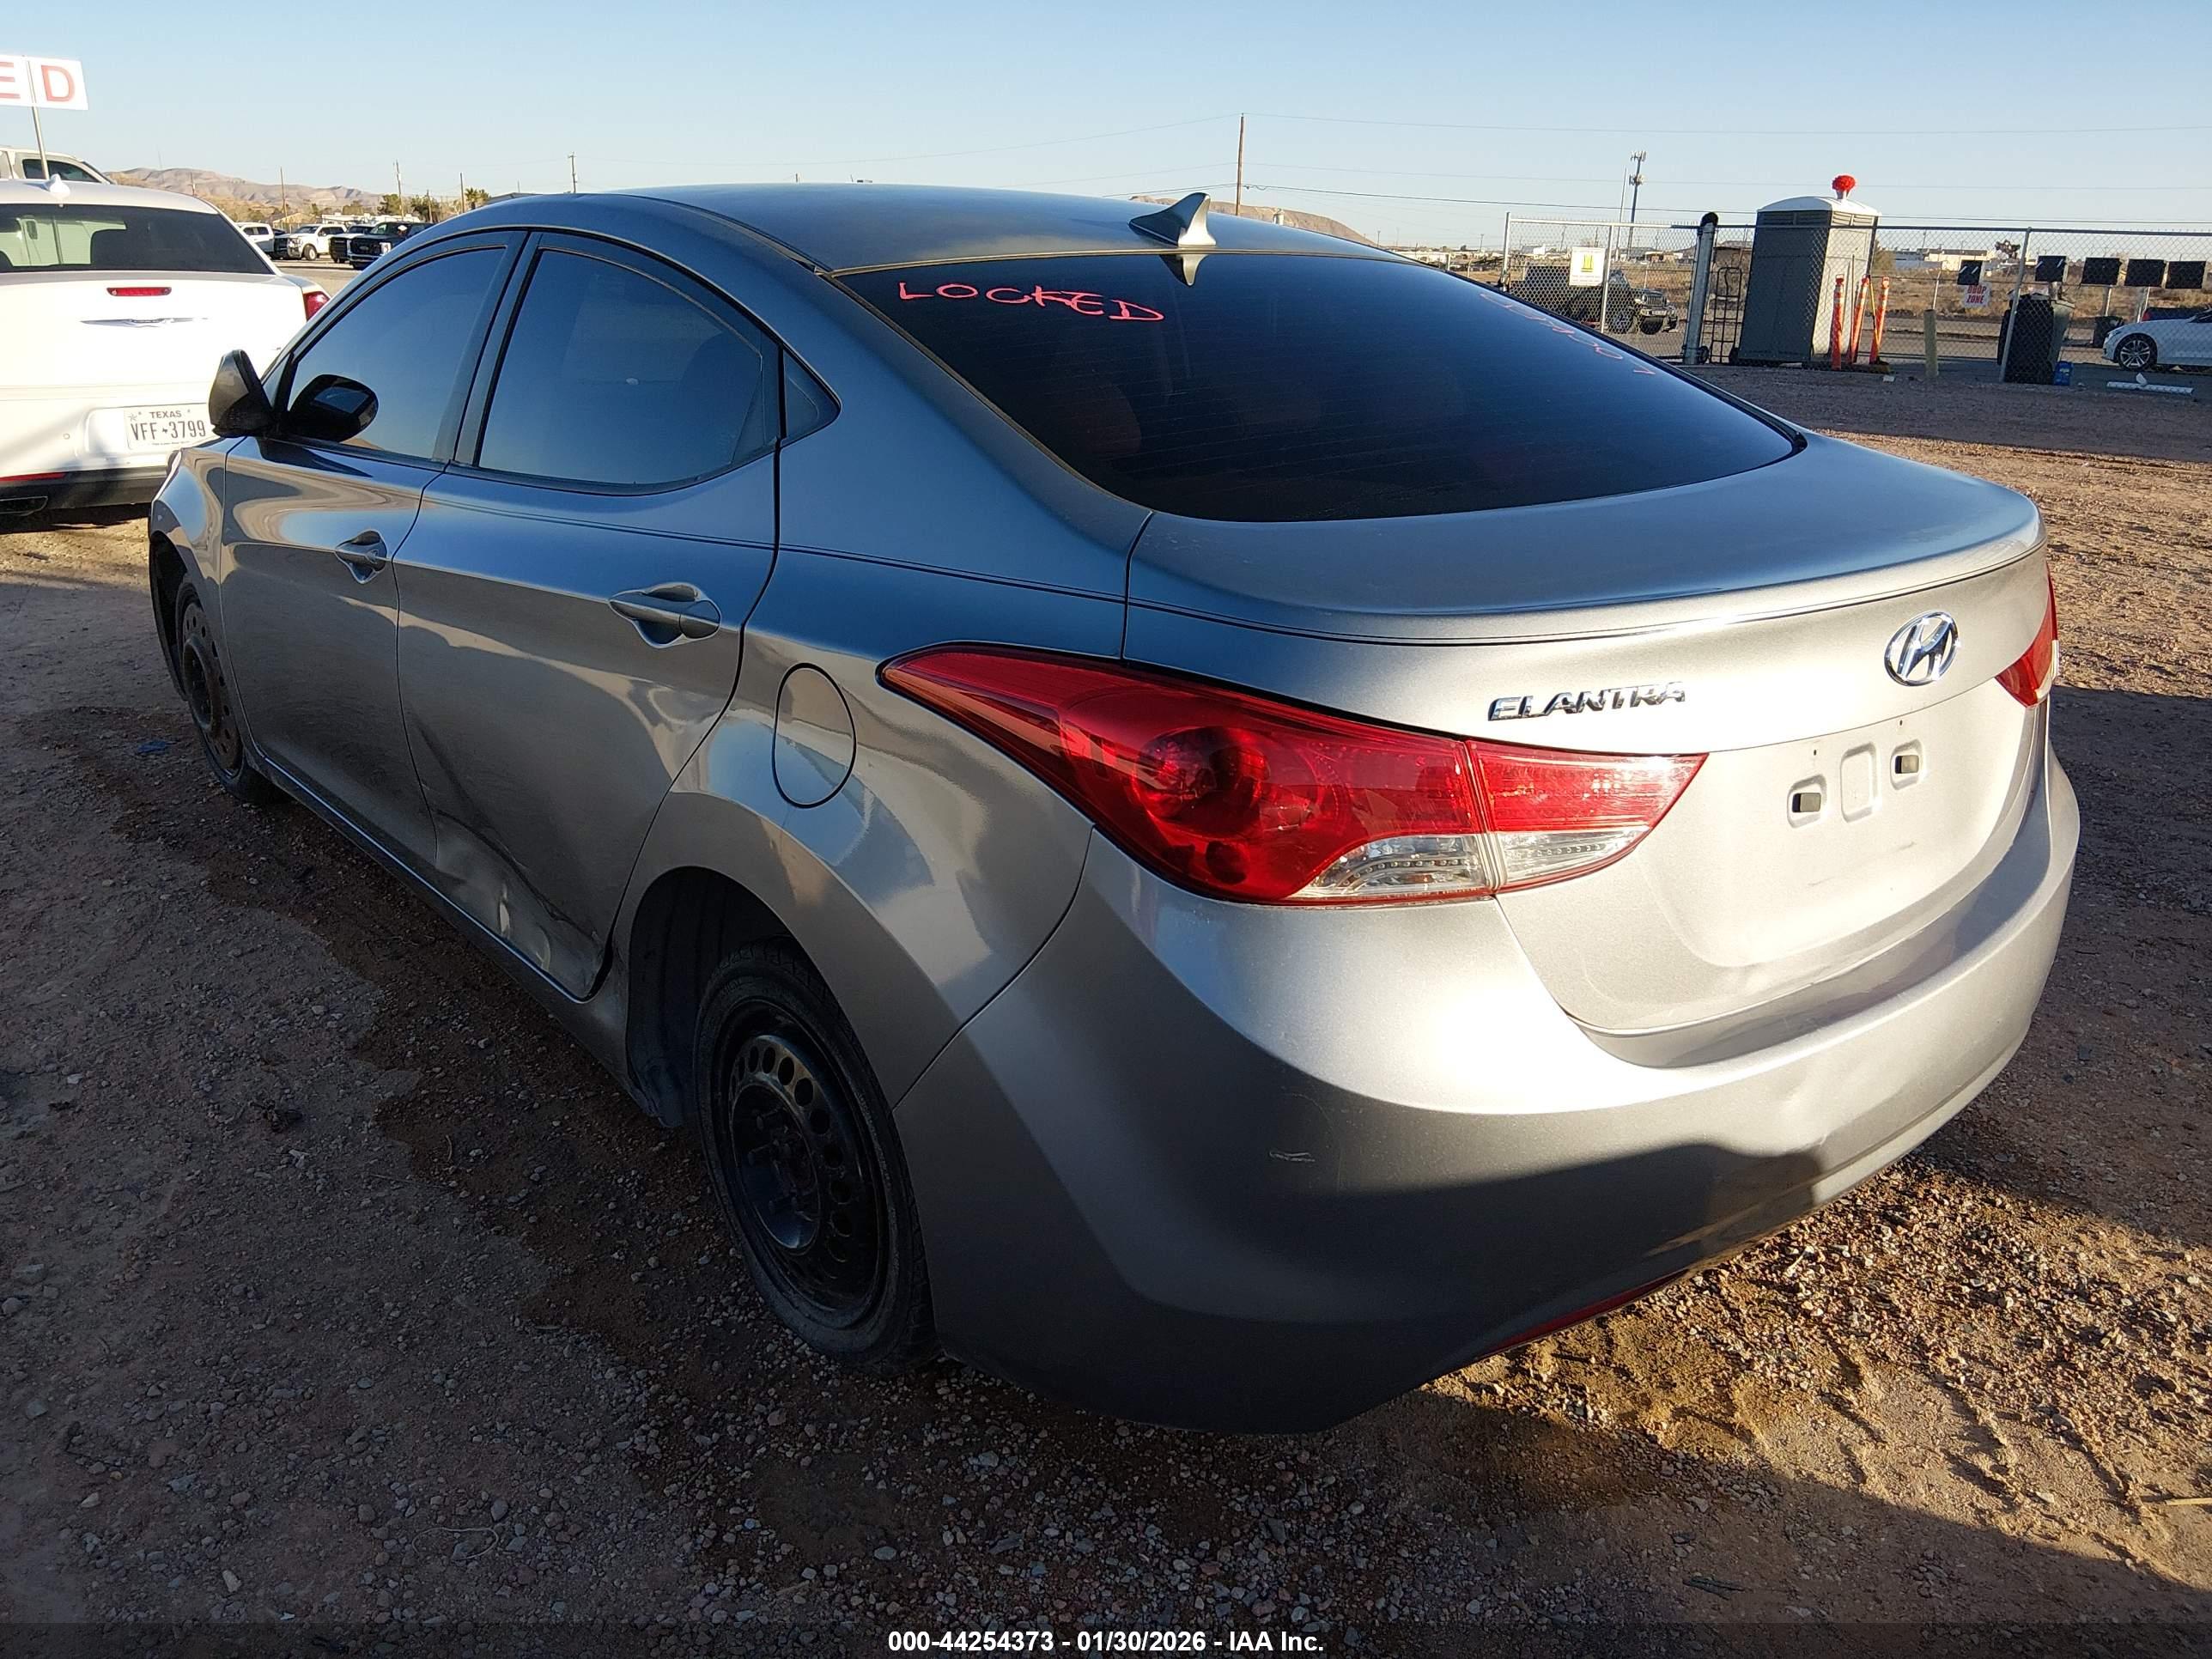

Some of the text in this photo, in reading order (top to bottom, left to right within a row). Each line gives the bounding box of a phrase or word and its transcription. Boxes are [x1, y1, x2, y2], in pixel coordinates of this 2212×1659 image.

[898, 282, 1164, 321] LOCKED
[1966, 295, 1984, 303] ZONE
[149, 410, 182, 419] TEXAS
[1488, 681, 1686, 721] ELANTRA
